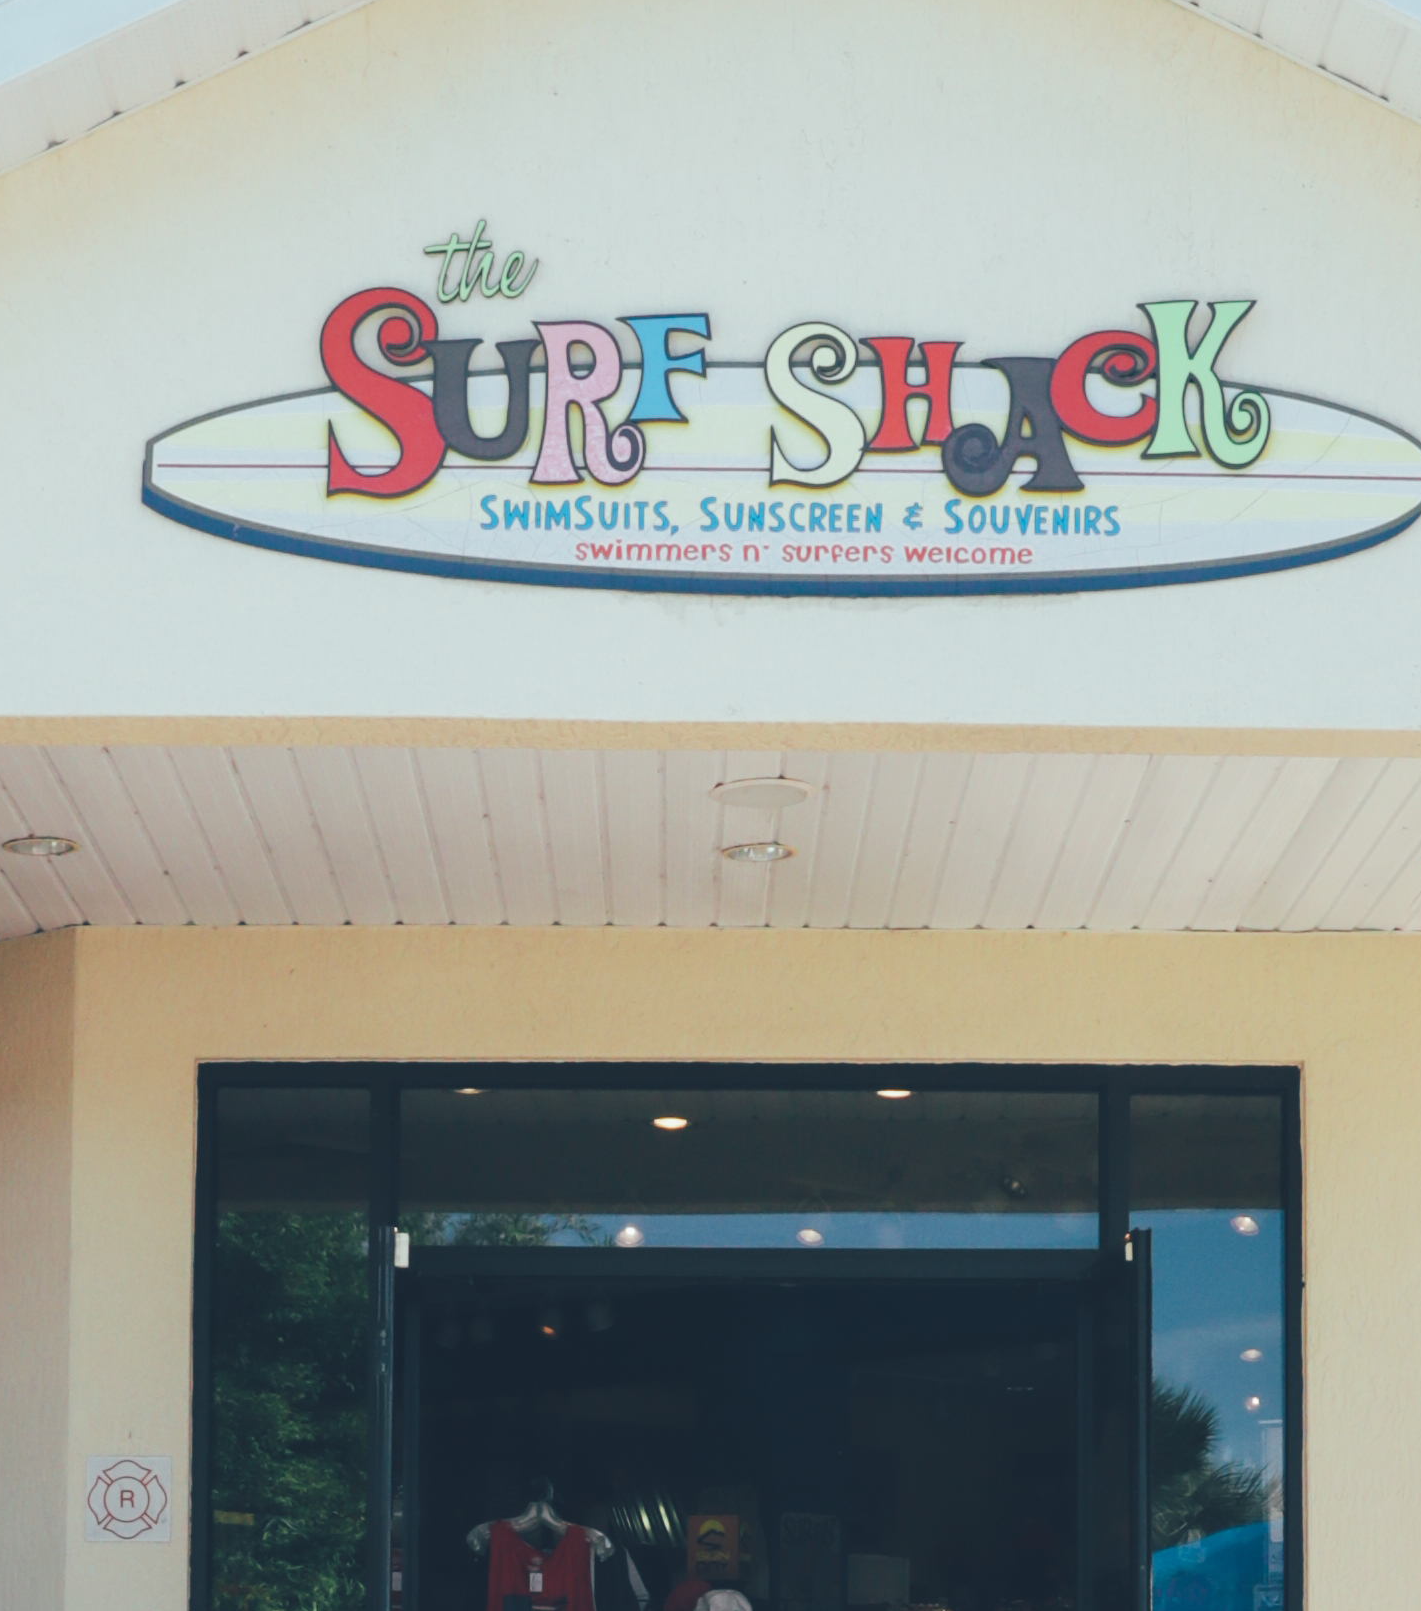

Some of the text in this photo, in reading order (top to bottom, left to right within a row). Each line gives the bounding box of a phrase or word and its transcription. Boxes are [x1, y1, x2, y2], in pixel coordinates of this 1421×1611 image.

[423, 219, 539, 303] the
[320, 286, 1272, 499] SURF SHACK
[700, 496, 883, 533] SUNSCREEN
[902, 501, 924, 531] &
[944, 499, 1121, 536] SOUVENIRS
[575, 539, 734, 563] swimmers
[782, 543, 895, 564] surfers
[904, 545, 1034, 565] welcome
[120, 1489, 135, 1508] R
